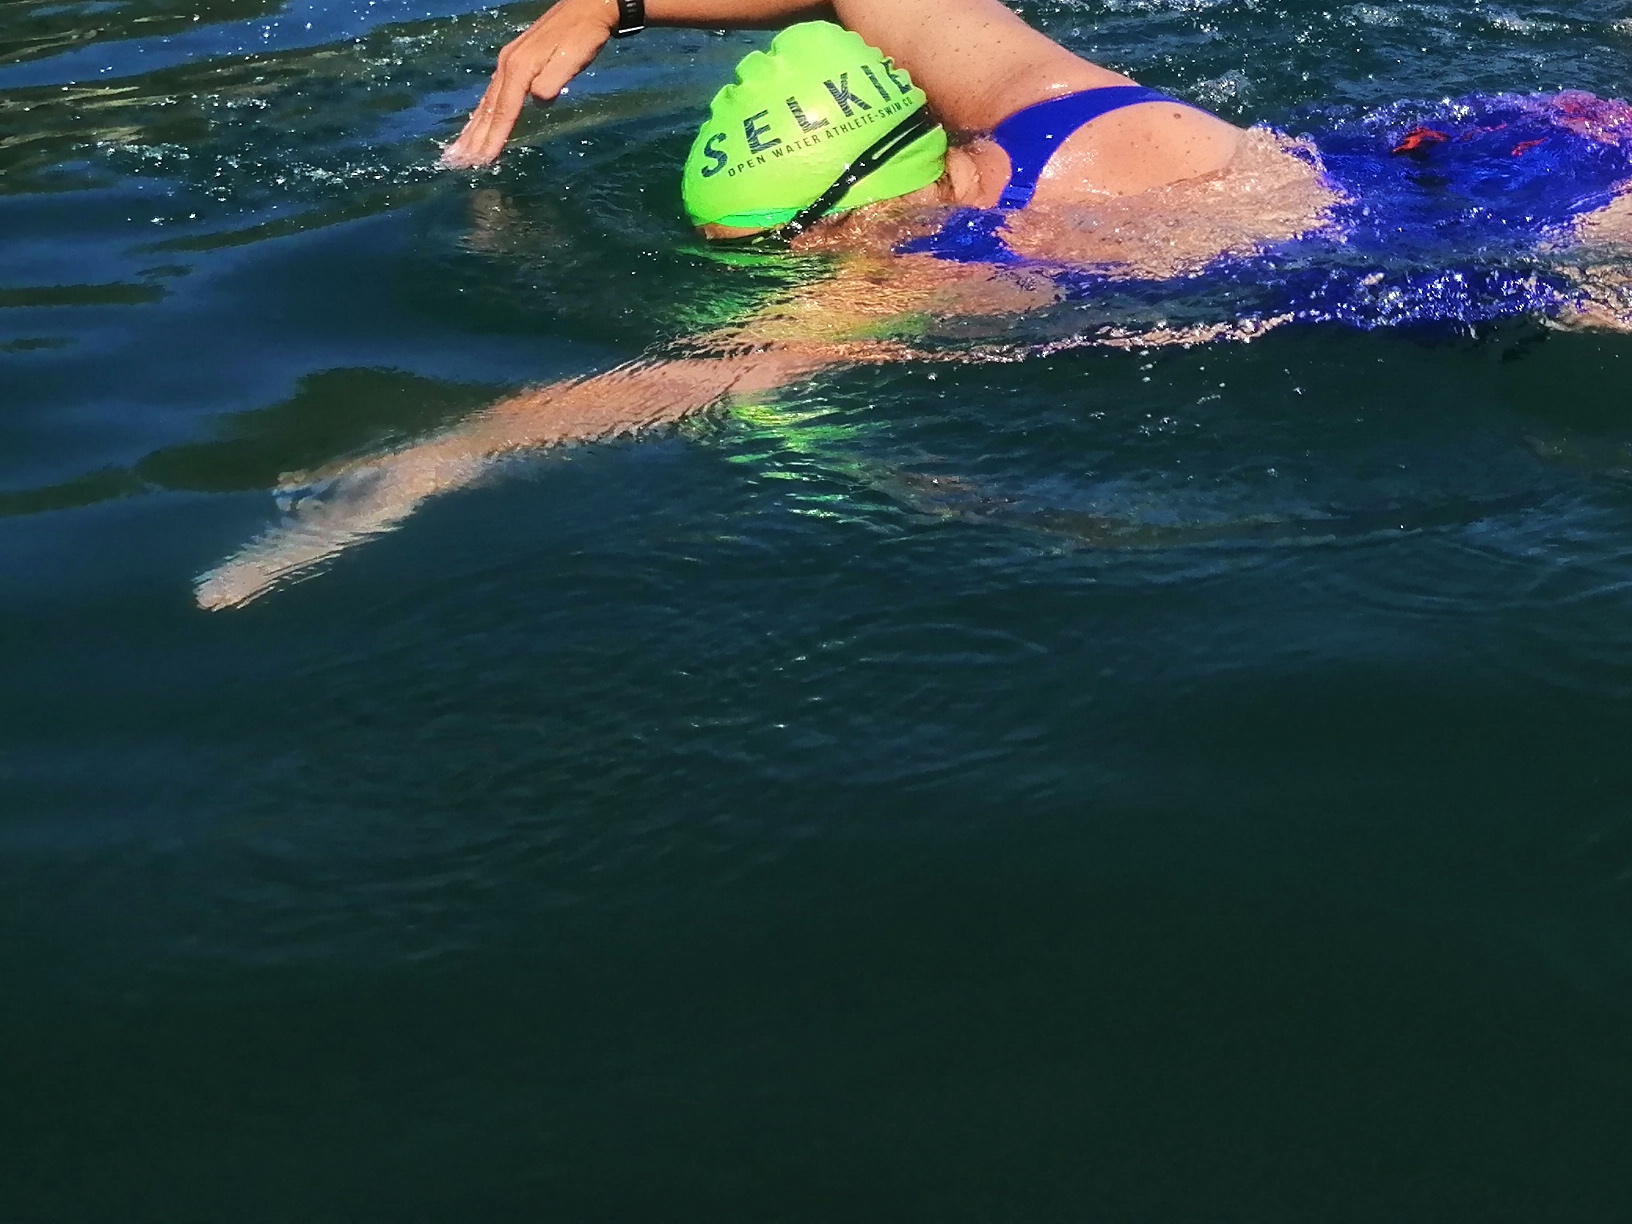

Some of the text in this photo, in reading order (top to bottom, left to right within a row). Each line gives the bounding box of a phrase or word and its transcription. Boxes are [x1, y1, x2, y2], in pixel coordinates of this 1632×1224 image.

[701, 59, 912, 177] SELKIE
[728, 155, 766, 176] OPEN
[771, 134, 820, 158] WATER
